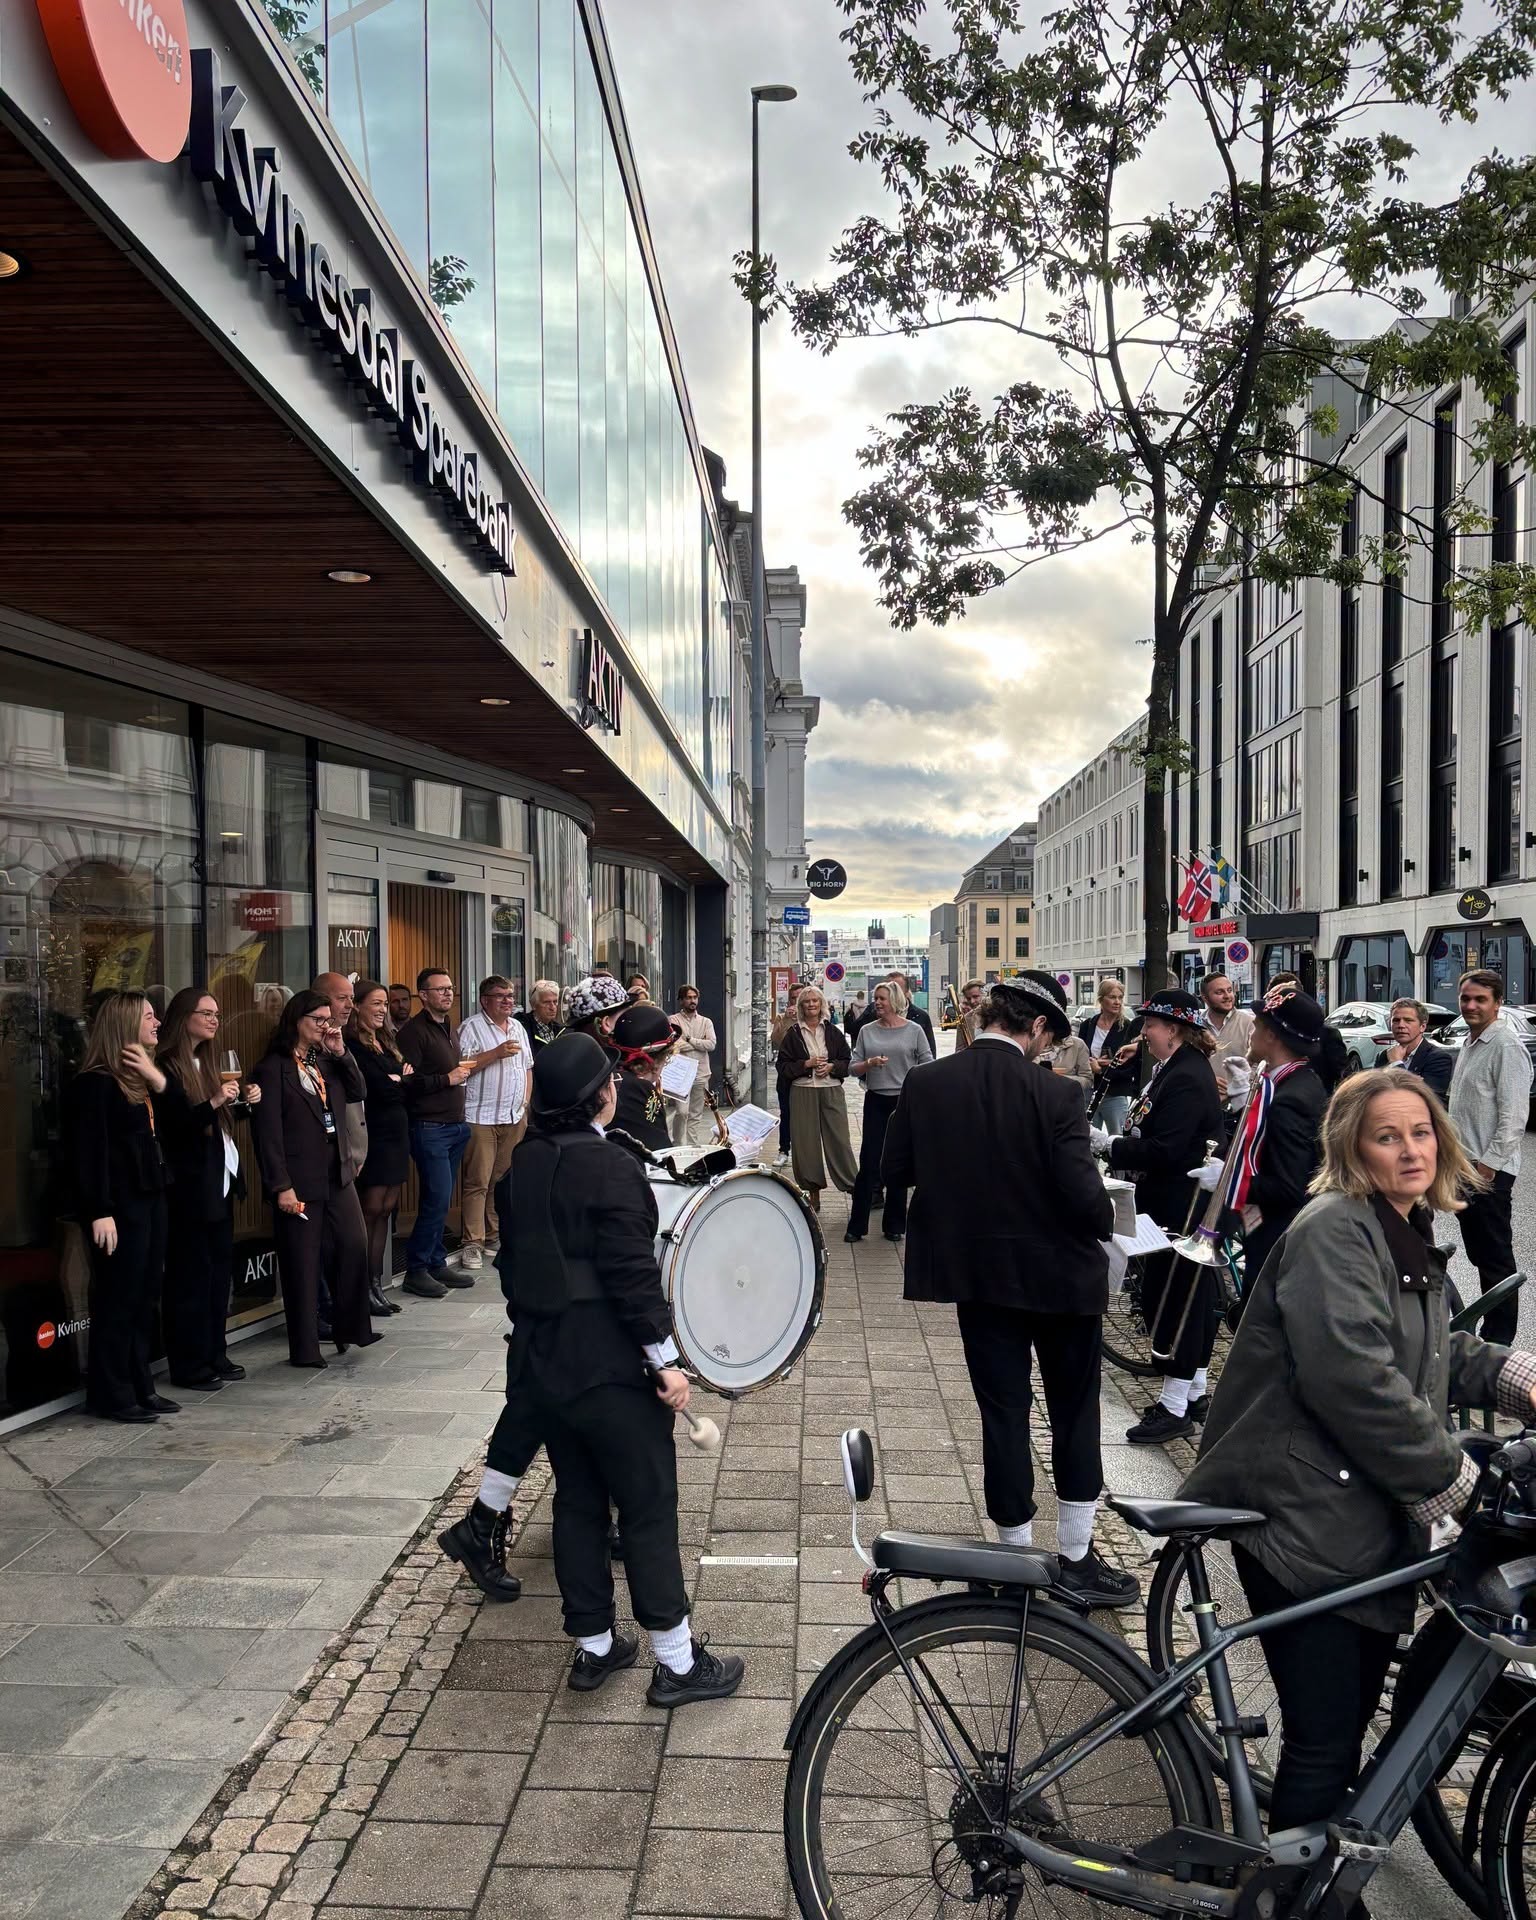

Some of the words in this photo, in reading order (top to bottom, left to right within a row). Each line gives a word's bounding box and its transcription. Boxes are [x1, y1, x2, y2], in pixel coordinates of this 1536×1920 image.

[191, 48, 405, 421] Kvinesdal
[404, 359, 518, 577] Sparebank
[584, 628, 625, 734] AKTIV
[337, 929, 371, 948] AKTIV
[1199, 1900, 1219, 1911] BOSCH
